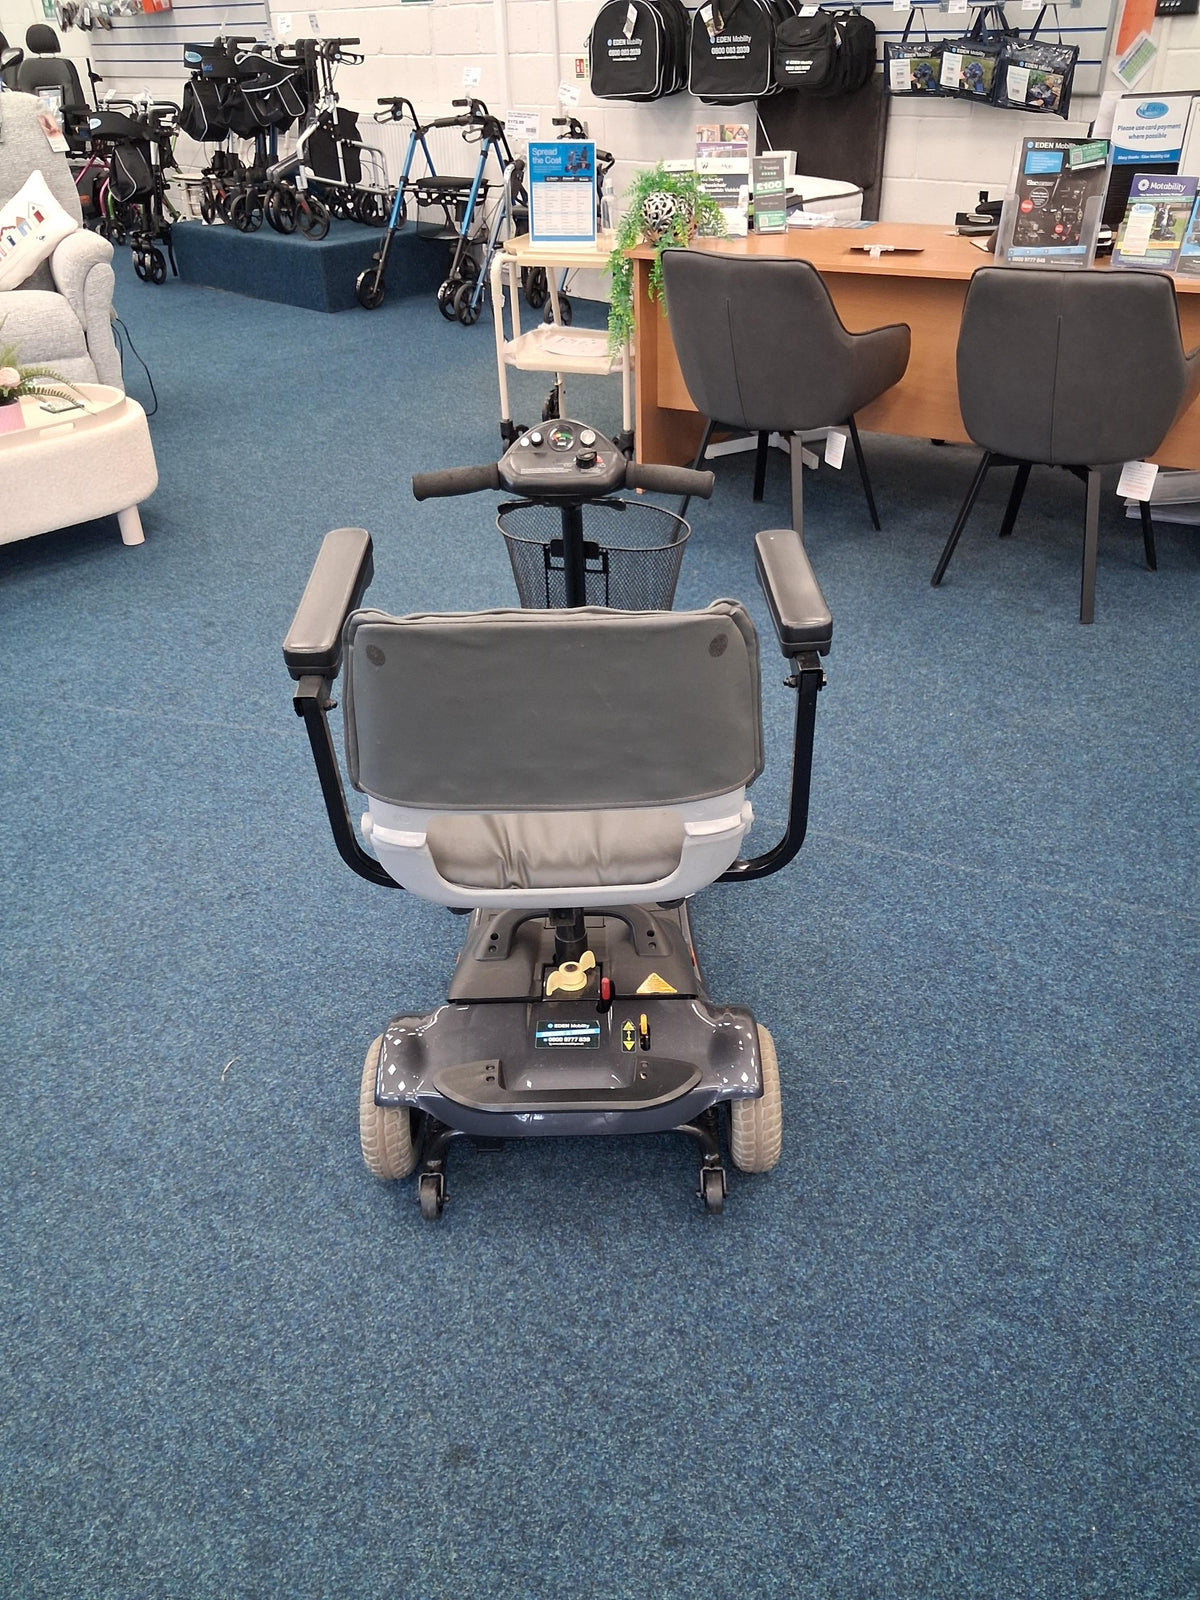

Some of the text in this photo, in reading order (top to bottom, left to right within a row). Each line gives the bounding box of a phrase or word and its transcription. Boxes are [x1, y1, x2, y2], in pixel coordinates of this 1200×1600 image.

[732, 34, 751, 43] Mobility
[1157, 123, 1181, 131] payment
[1145, 132, 1167, 140] possible
[1035, 141, 1054, 149] EDEN
[532, 148, 557, 156] Spread
[544, 156, 562, 164] Cost
[756, 181, 782, 191] £100
[1150, 182, 1186, 193] Motability
